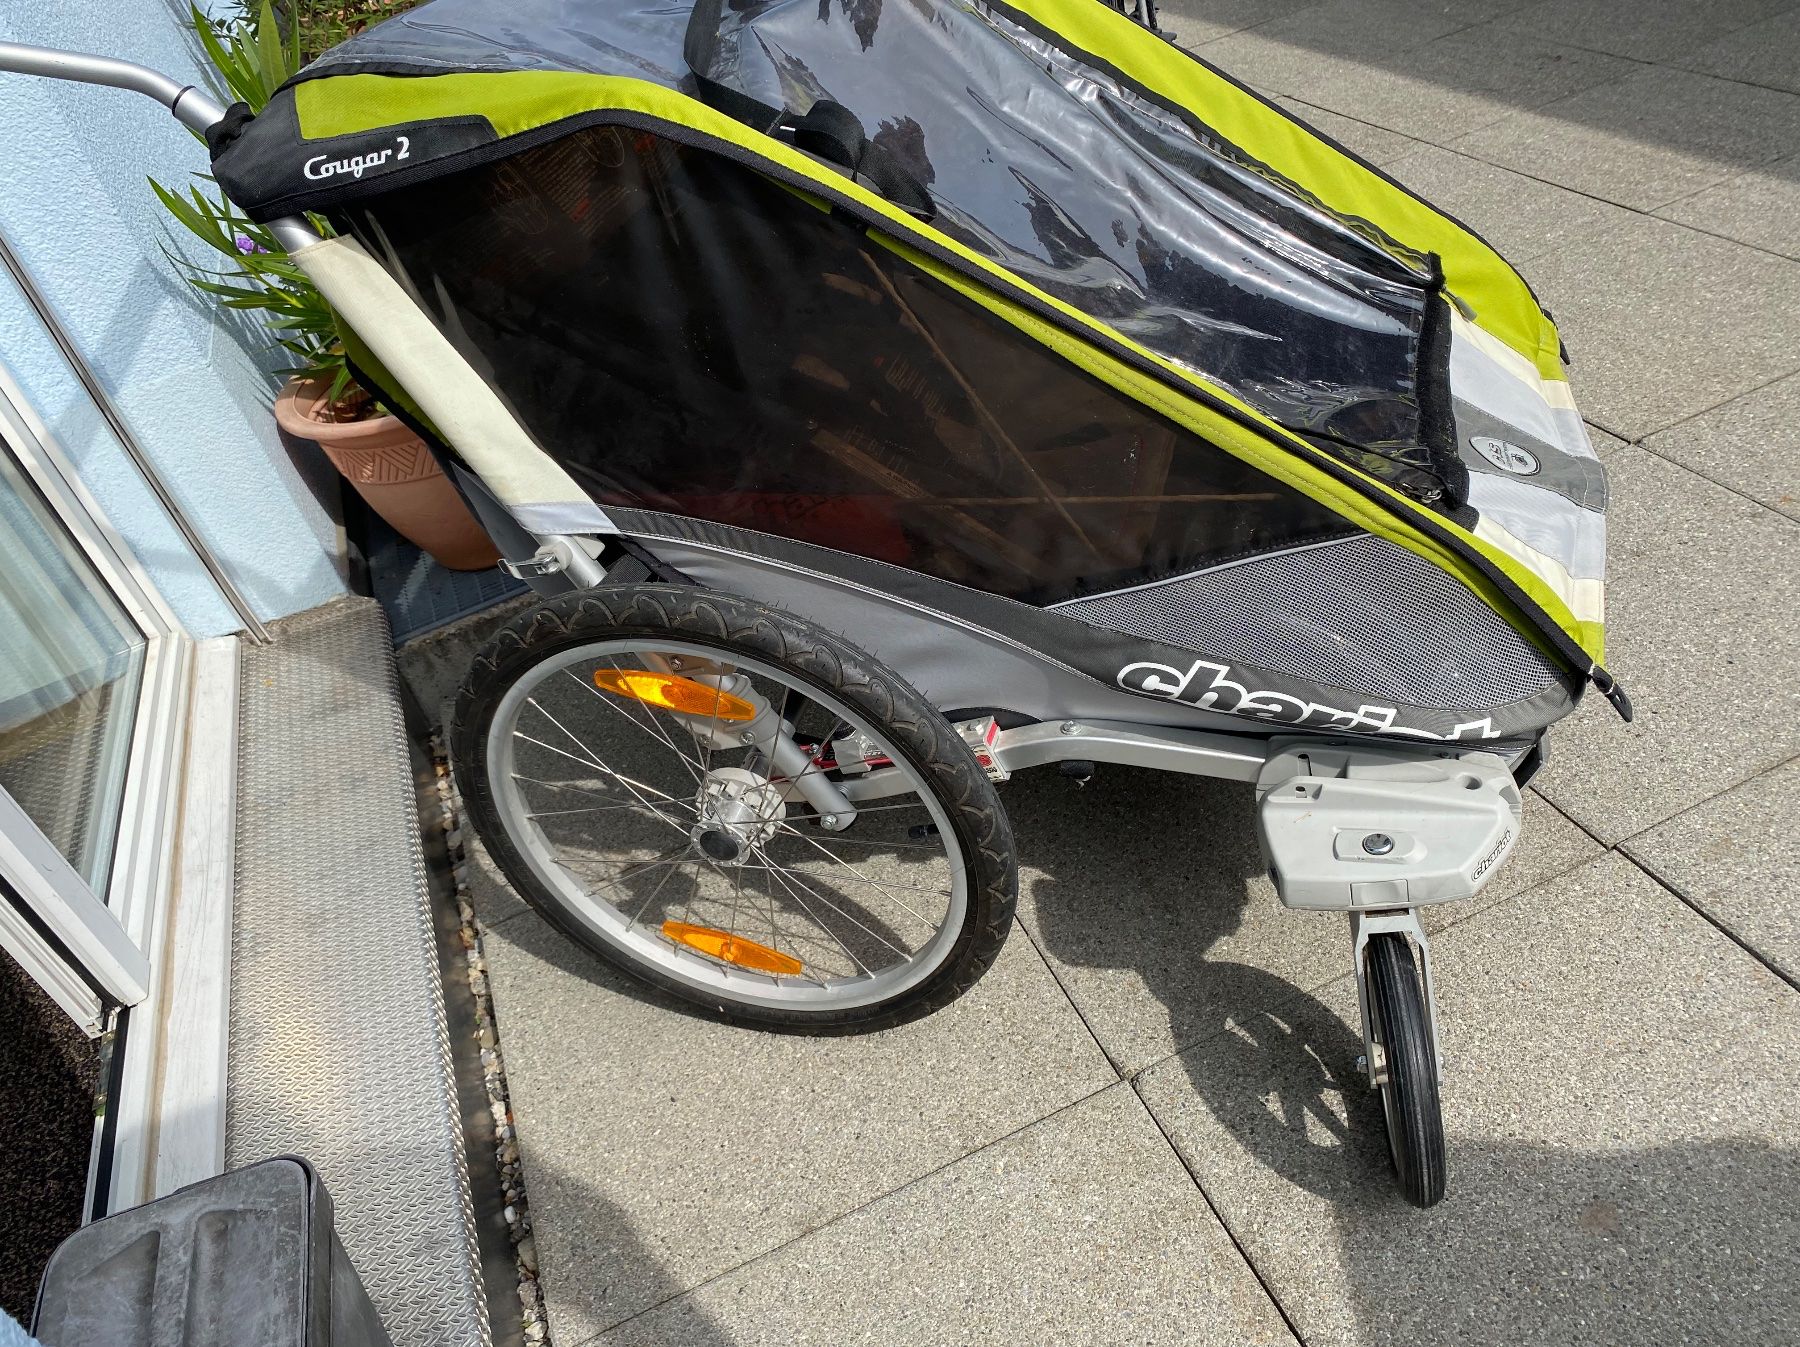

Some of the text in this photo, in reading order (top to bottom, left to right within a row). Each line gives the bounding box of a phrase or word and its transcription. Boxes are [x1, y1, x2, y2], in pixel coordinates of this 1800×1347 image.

[303, 136, 410, 180] Cougar 2
[1116, 659, 1502, 741] chari
[1472, 829, 1512, 881] chariot
